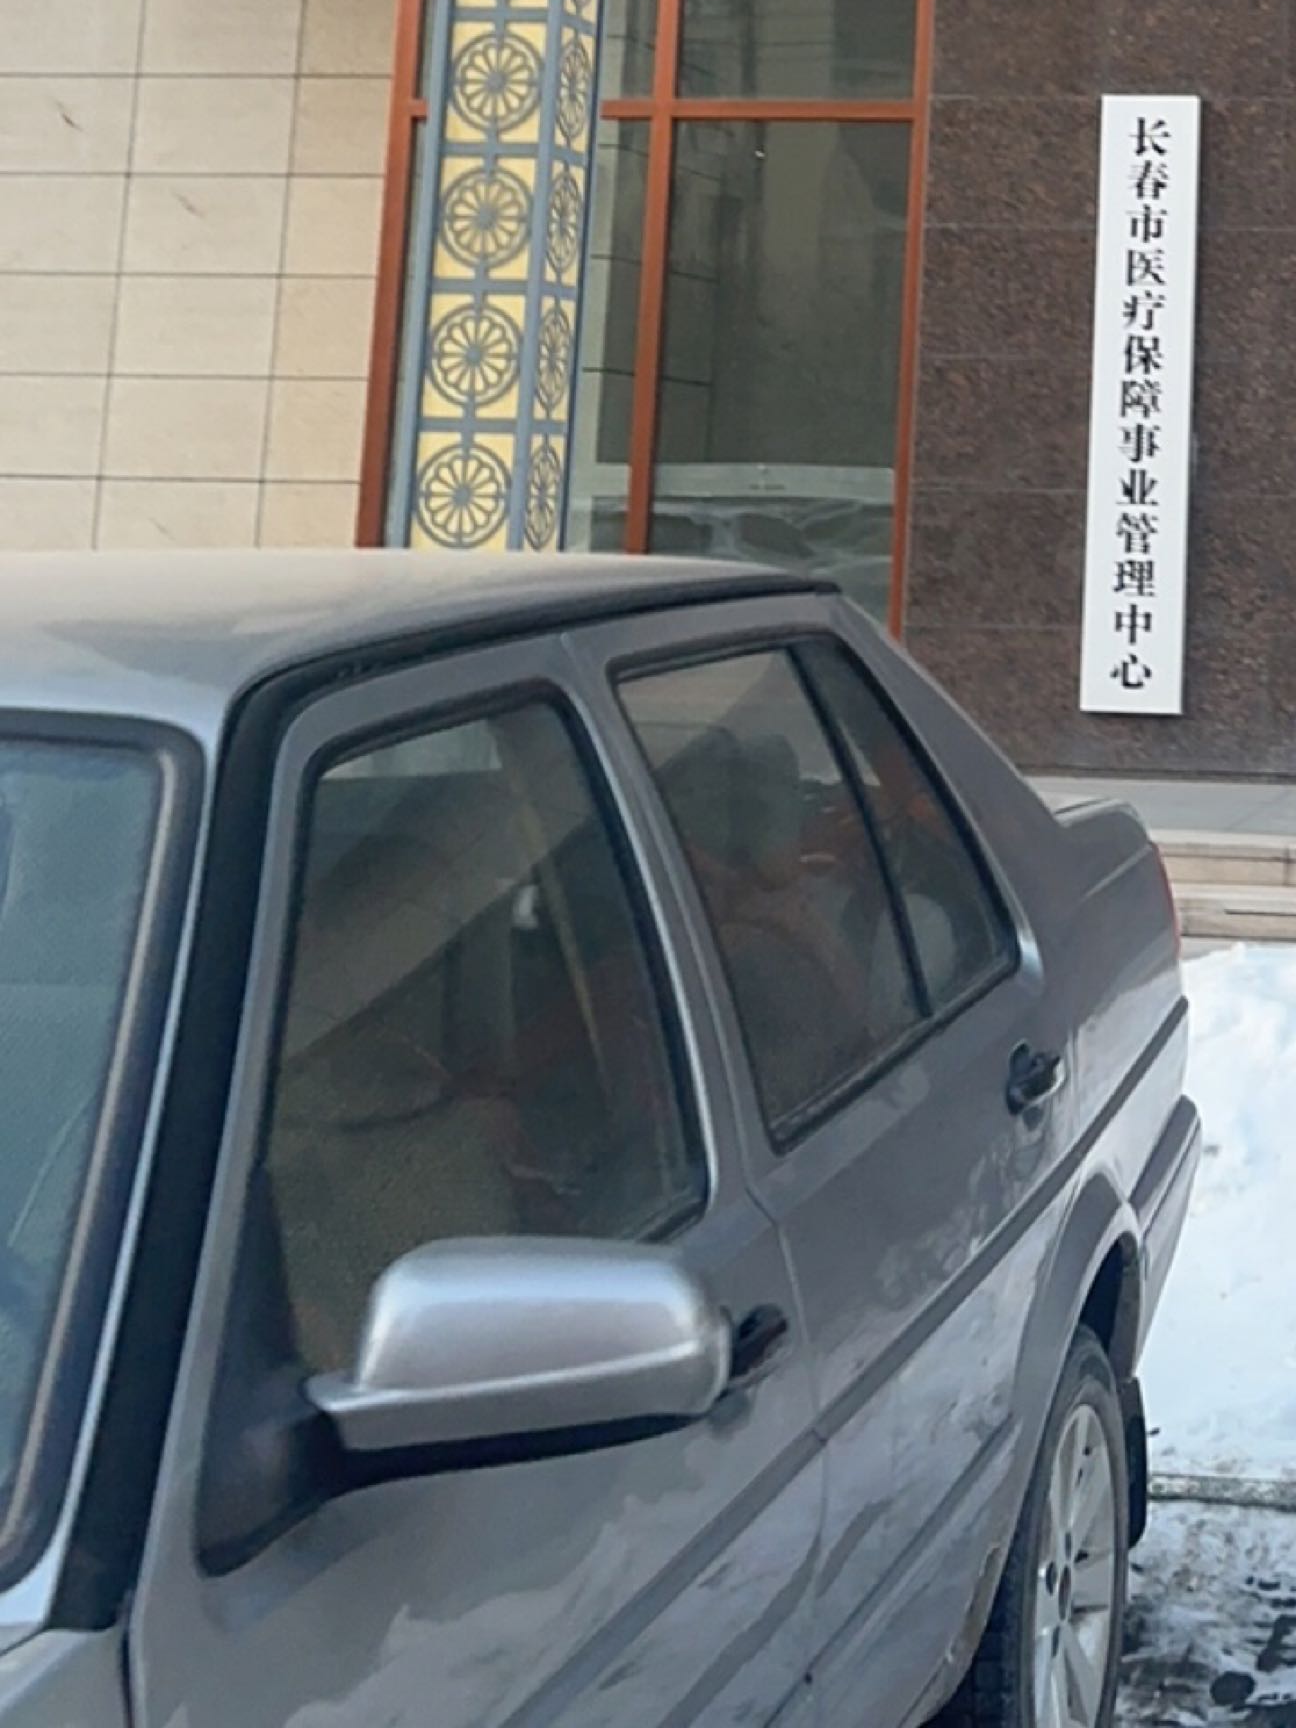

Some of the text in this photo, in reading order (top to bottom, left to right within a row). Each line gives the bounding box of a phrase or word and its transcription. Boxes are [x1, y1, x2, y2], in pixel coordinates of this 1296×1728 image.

[1110, 116, 1171, 690] 长春市医疗保障事业管理中心
